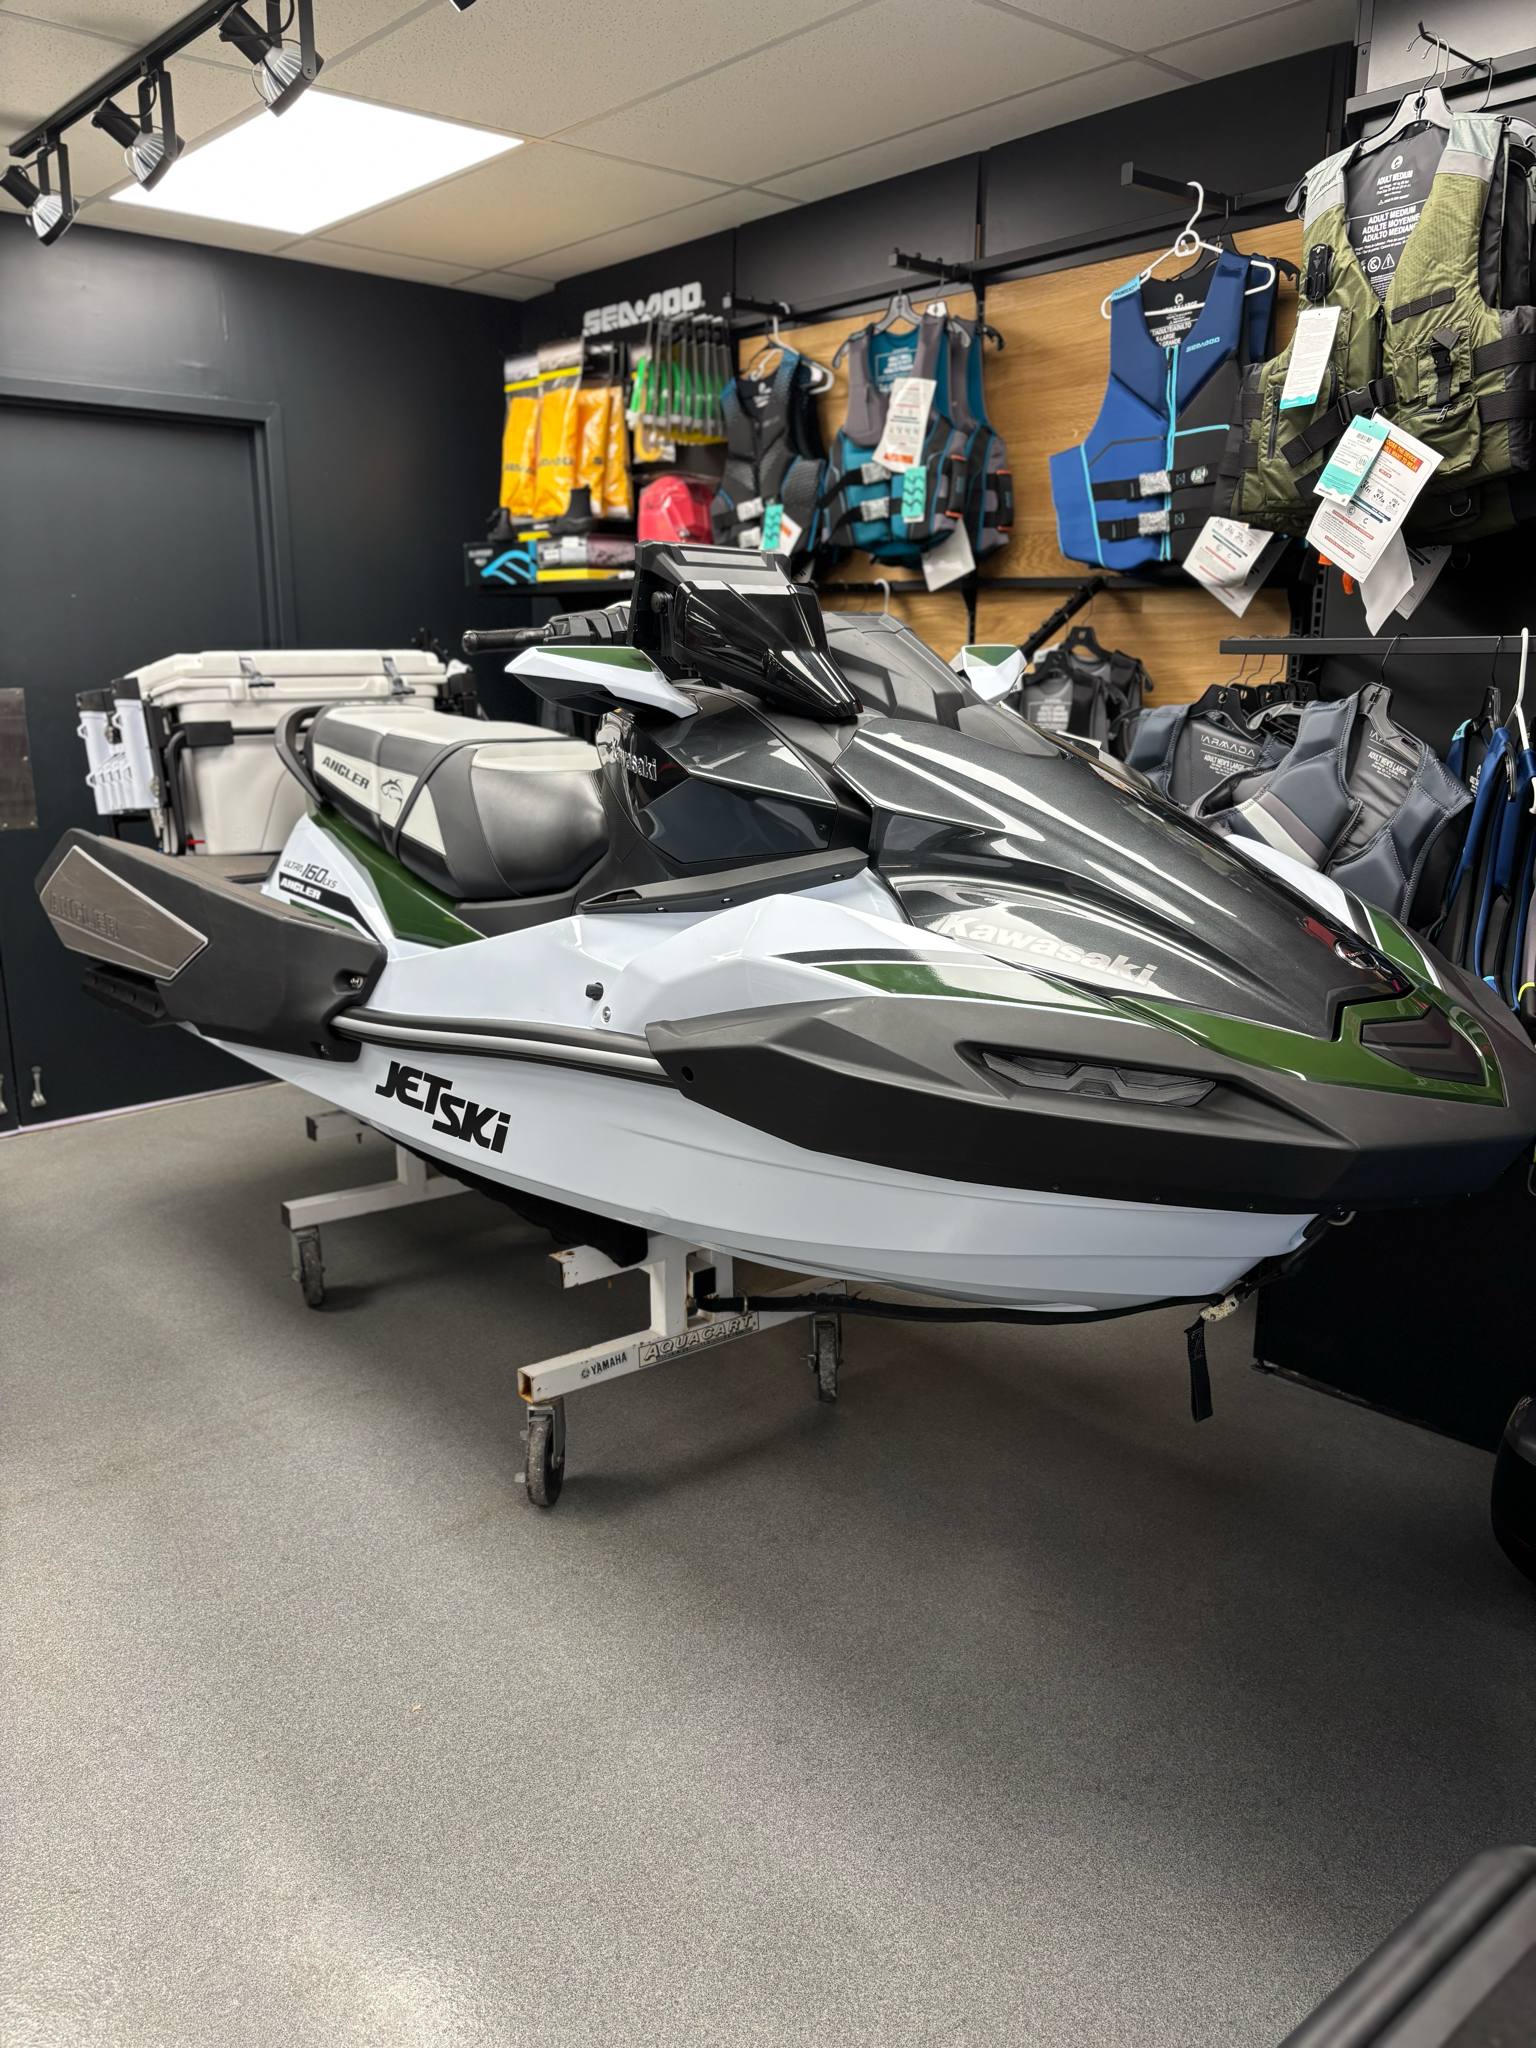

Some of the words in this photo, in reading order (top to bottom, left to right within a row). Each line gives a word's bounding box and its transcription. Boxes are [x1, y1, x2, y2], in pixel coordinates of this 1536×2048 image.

[1376, 174, 1393, 186] ADULT
[1392, 169, 1414, 181] MEDIUM
[1368, 212, 1390, 225] ADULT
[1389, 205, 1417, 219] MEDIUM
[1361, 222, 1388, 235] ADULTE
[1361, 230, 1388, 243] ADULTO
[320, 755, 371, 790] ANGLER
[282, 858, 304, 873] ULTRA
[280, 876, 322, 901] ANGLER
[936, 913, 1158, 986] Kawasaki
[643, 1313, 753, 1362] AQUACART
[590, 1351, 628, 1376] YAMAHA
